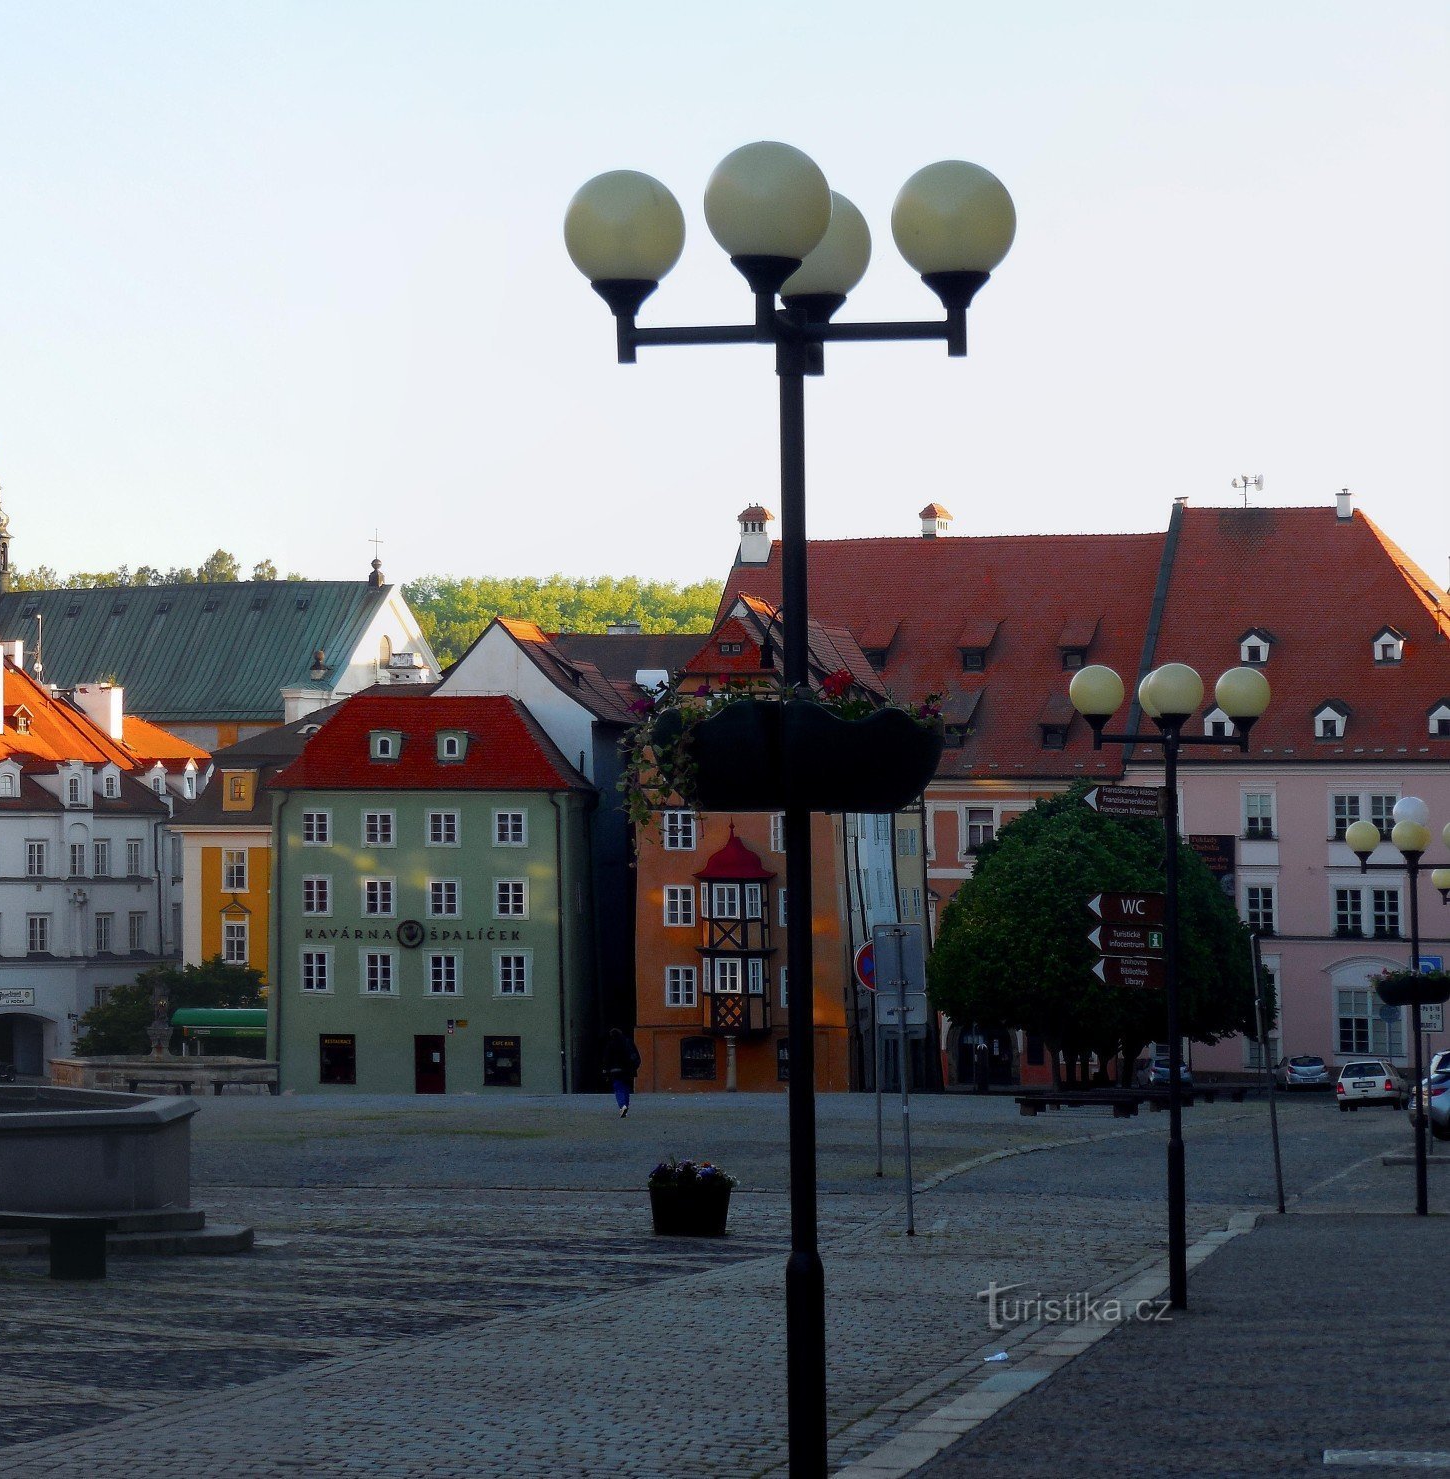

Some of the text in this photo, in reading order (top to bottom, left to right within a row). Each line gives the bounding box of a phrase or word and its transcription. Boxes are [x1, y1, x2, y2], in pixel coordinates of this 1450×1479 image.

[1121, 900, 1145, 915] WC
[305, 927, 521, 941] KAVÁRNA ŠPALÍČEK
